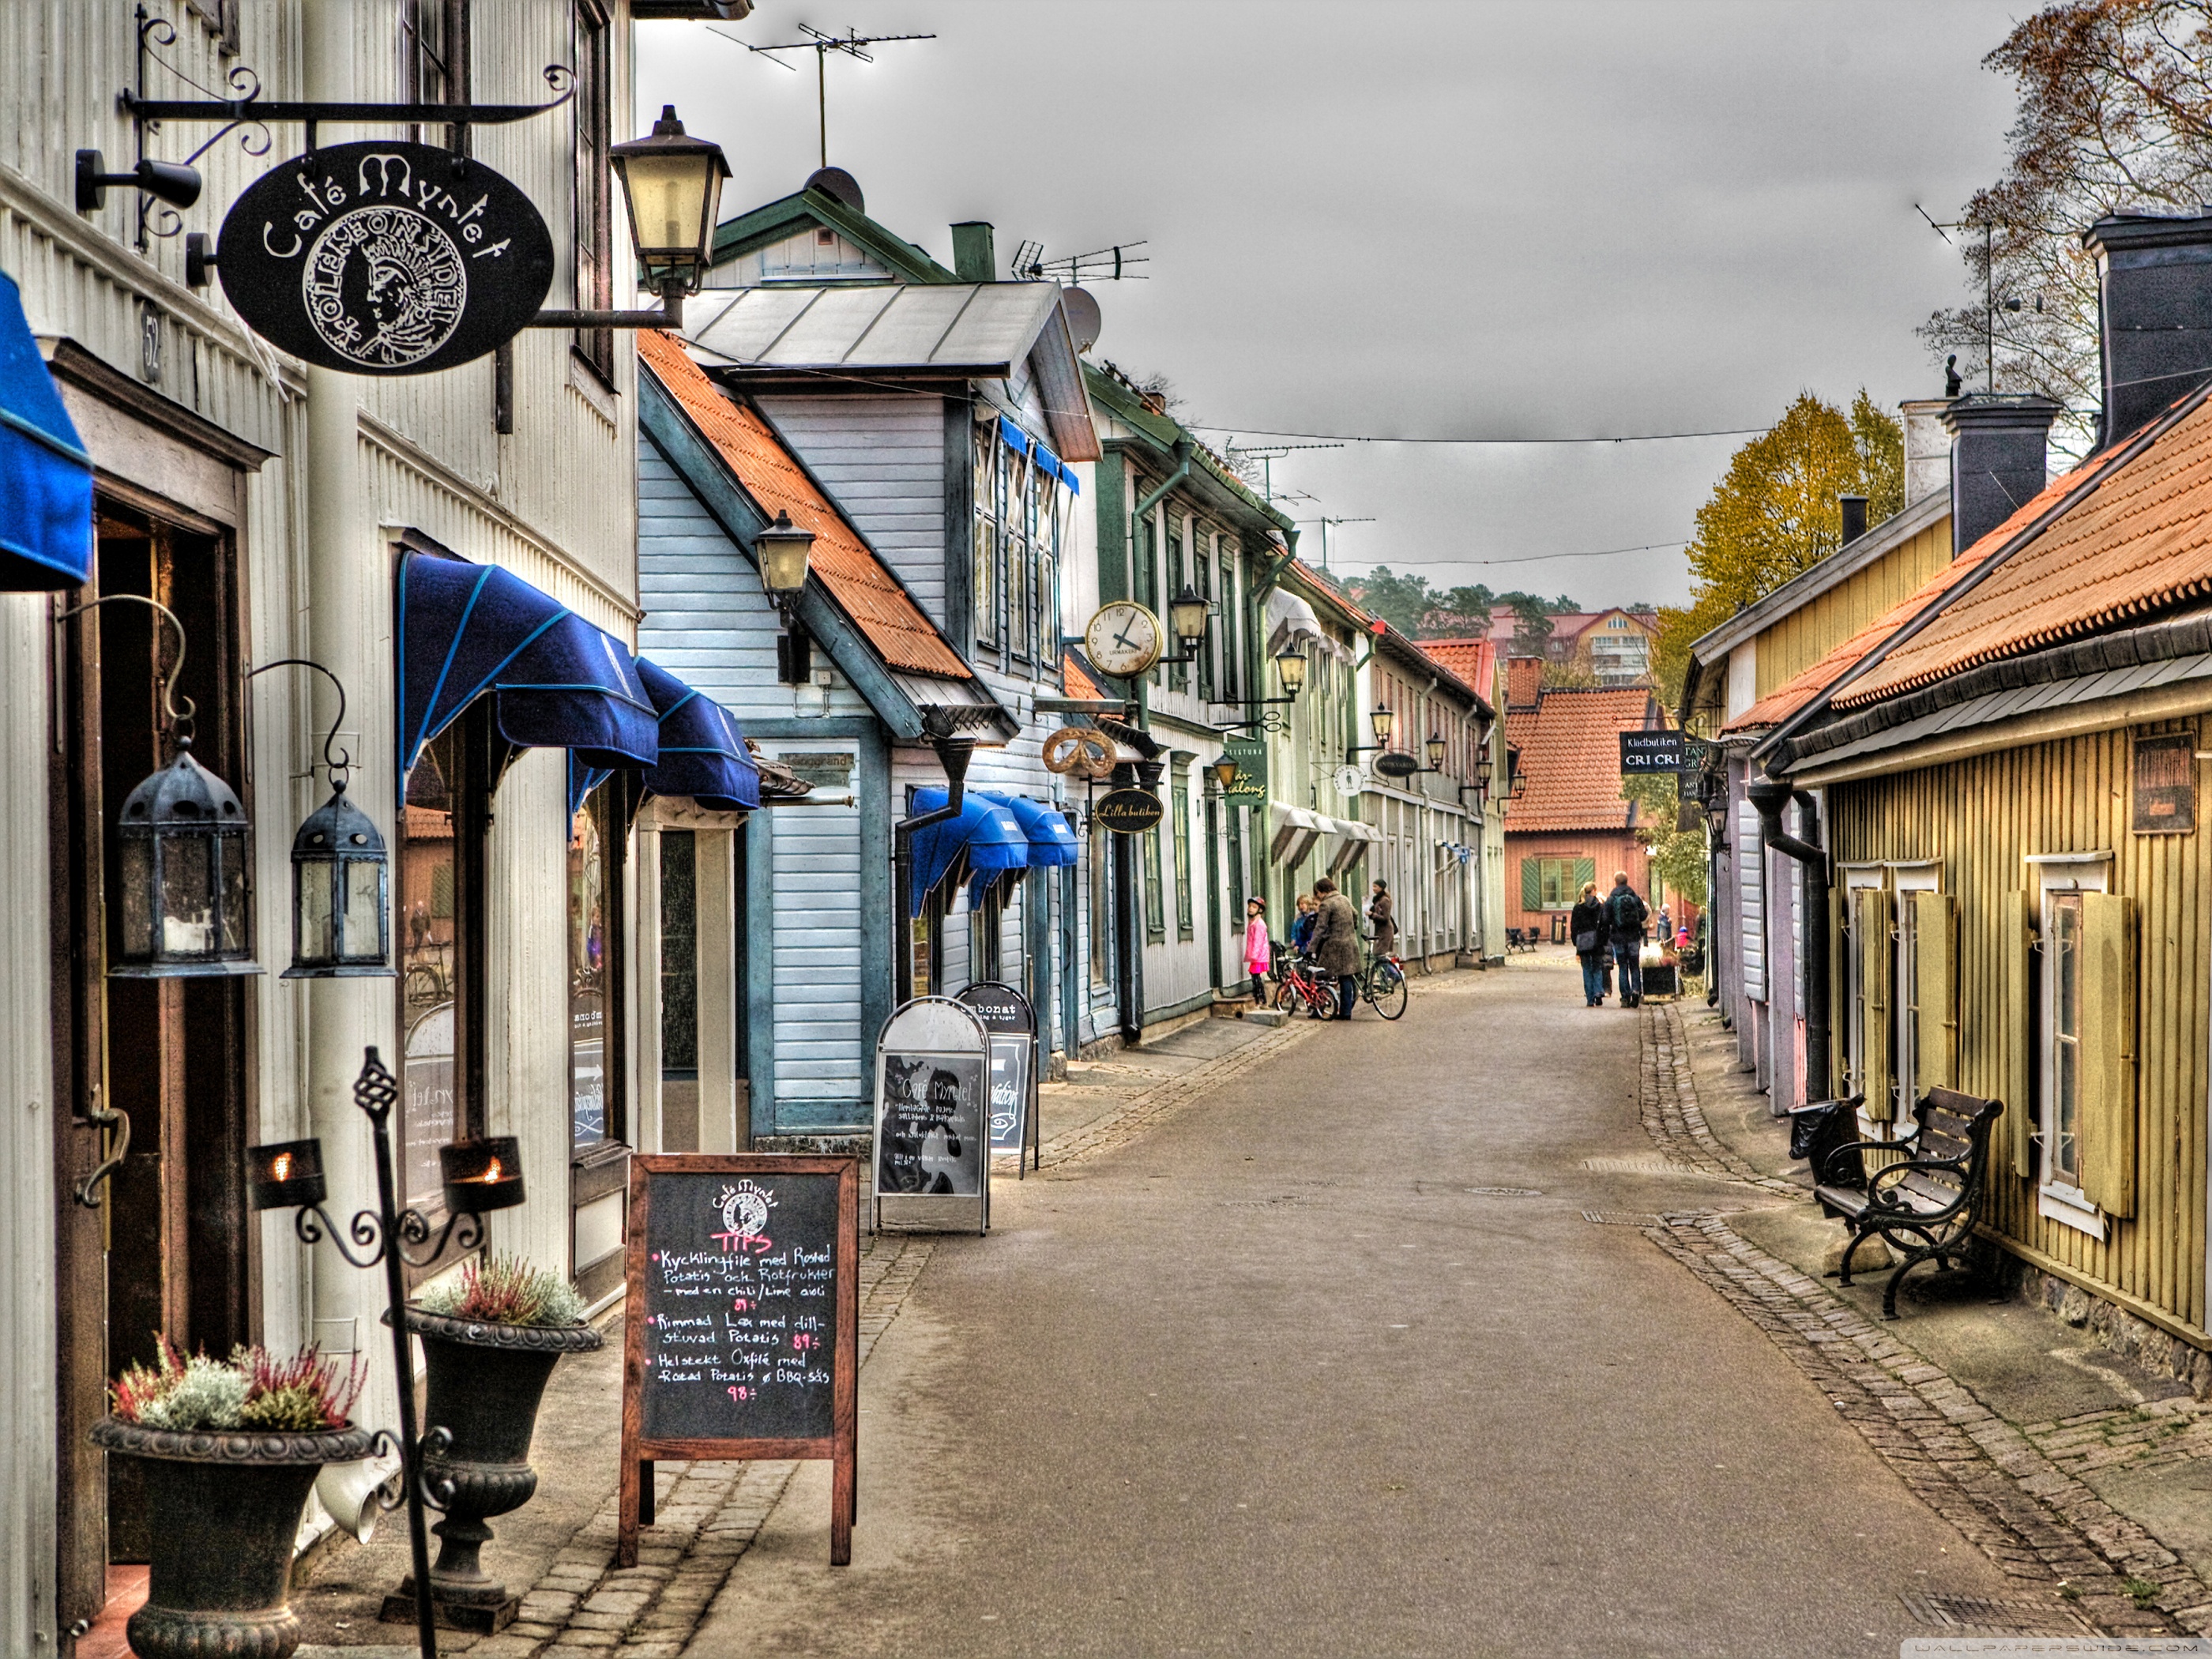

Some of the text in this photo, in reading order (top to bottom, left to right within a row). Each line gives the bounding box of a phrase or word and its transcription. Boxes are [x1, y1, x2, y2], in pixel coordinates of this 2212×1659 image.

[263, 153, 511, 258] Café Myntet
[145, 315, 159, 369] 52
[1115, 608, 1125, 617] 12
[1093, 623, 1102, 633] 10
[1141, 619, 1149, 629] 2
[1091, 637, 1099, 646] 9
[1146, 633, 1153, 642] 3
[1096, 650, 1103, 660] 8
[1106, 660, 1113, 669] 7
[1120, 662, 1127, 672] 6
[1684, 747, 1706, 756] TAN
[1625, 754, 1680, 766] CRI CRI
[1099, 803, 1160, 816] Lilla butiken
[712, 1179, 779, 1209] Café Myntet
[709, 1232, 773, 1255] TIPS
[759, 1251, 787, 1267] med
[664, 1267, 836, 1286] Potatis och Rotfrukter
[675, 1286, 700, 1296] med
[800, 1284, 825, 1296] aioli
[656, 1313, 712, 1330] Rimmad
[725, 1311, 753, 1328] Lax
[759, 1315, 786, 1328] med
[662, 1330, 716, 1344] stuvad
[728, 1330, 779, 1346] Potatis
[658, 1353, 721, 1367] Helstekt
[777, 1351, 806, 1368] med
[711, 1367, 754, 1381] Potatis
